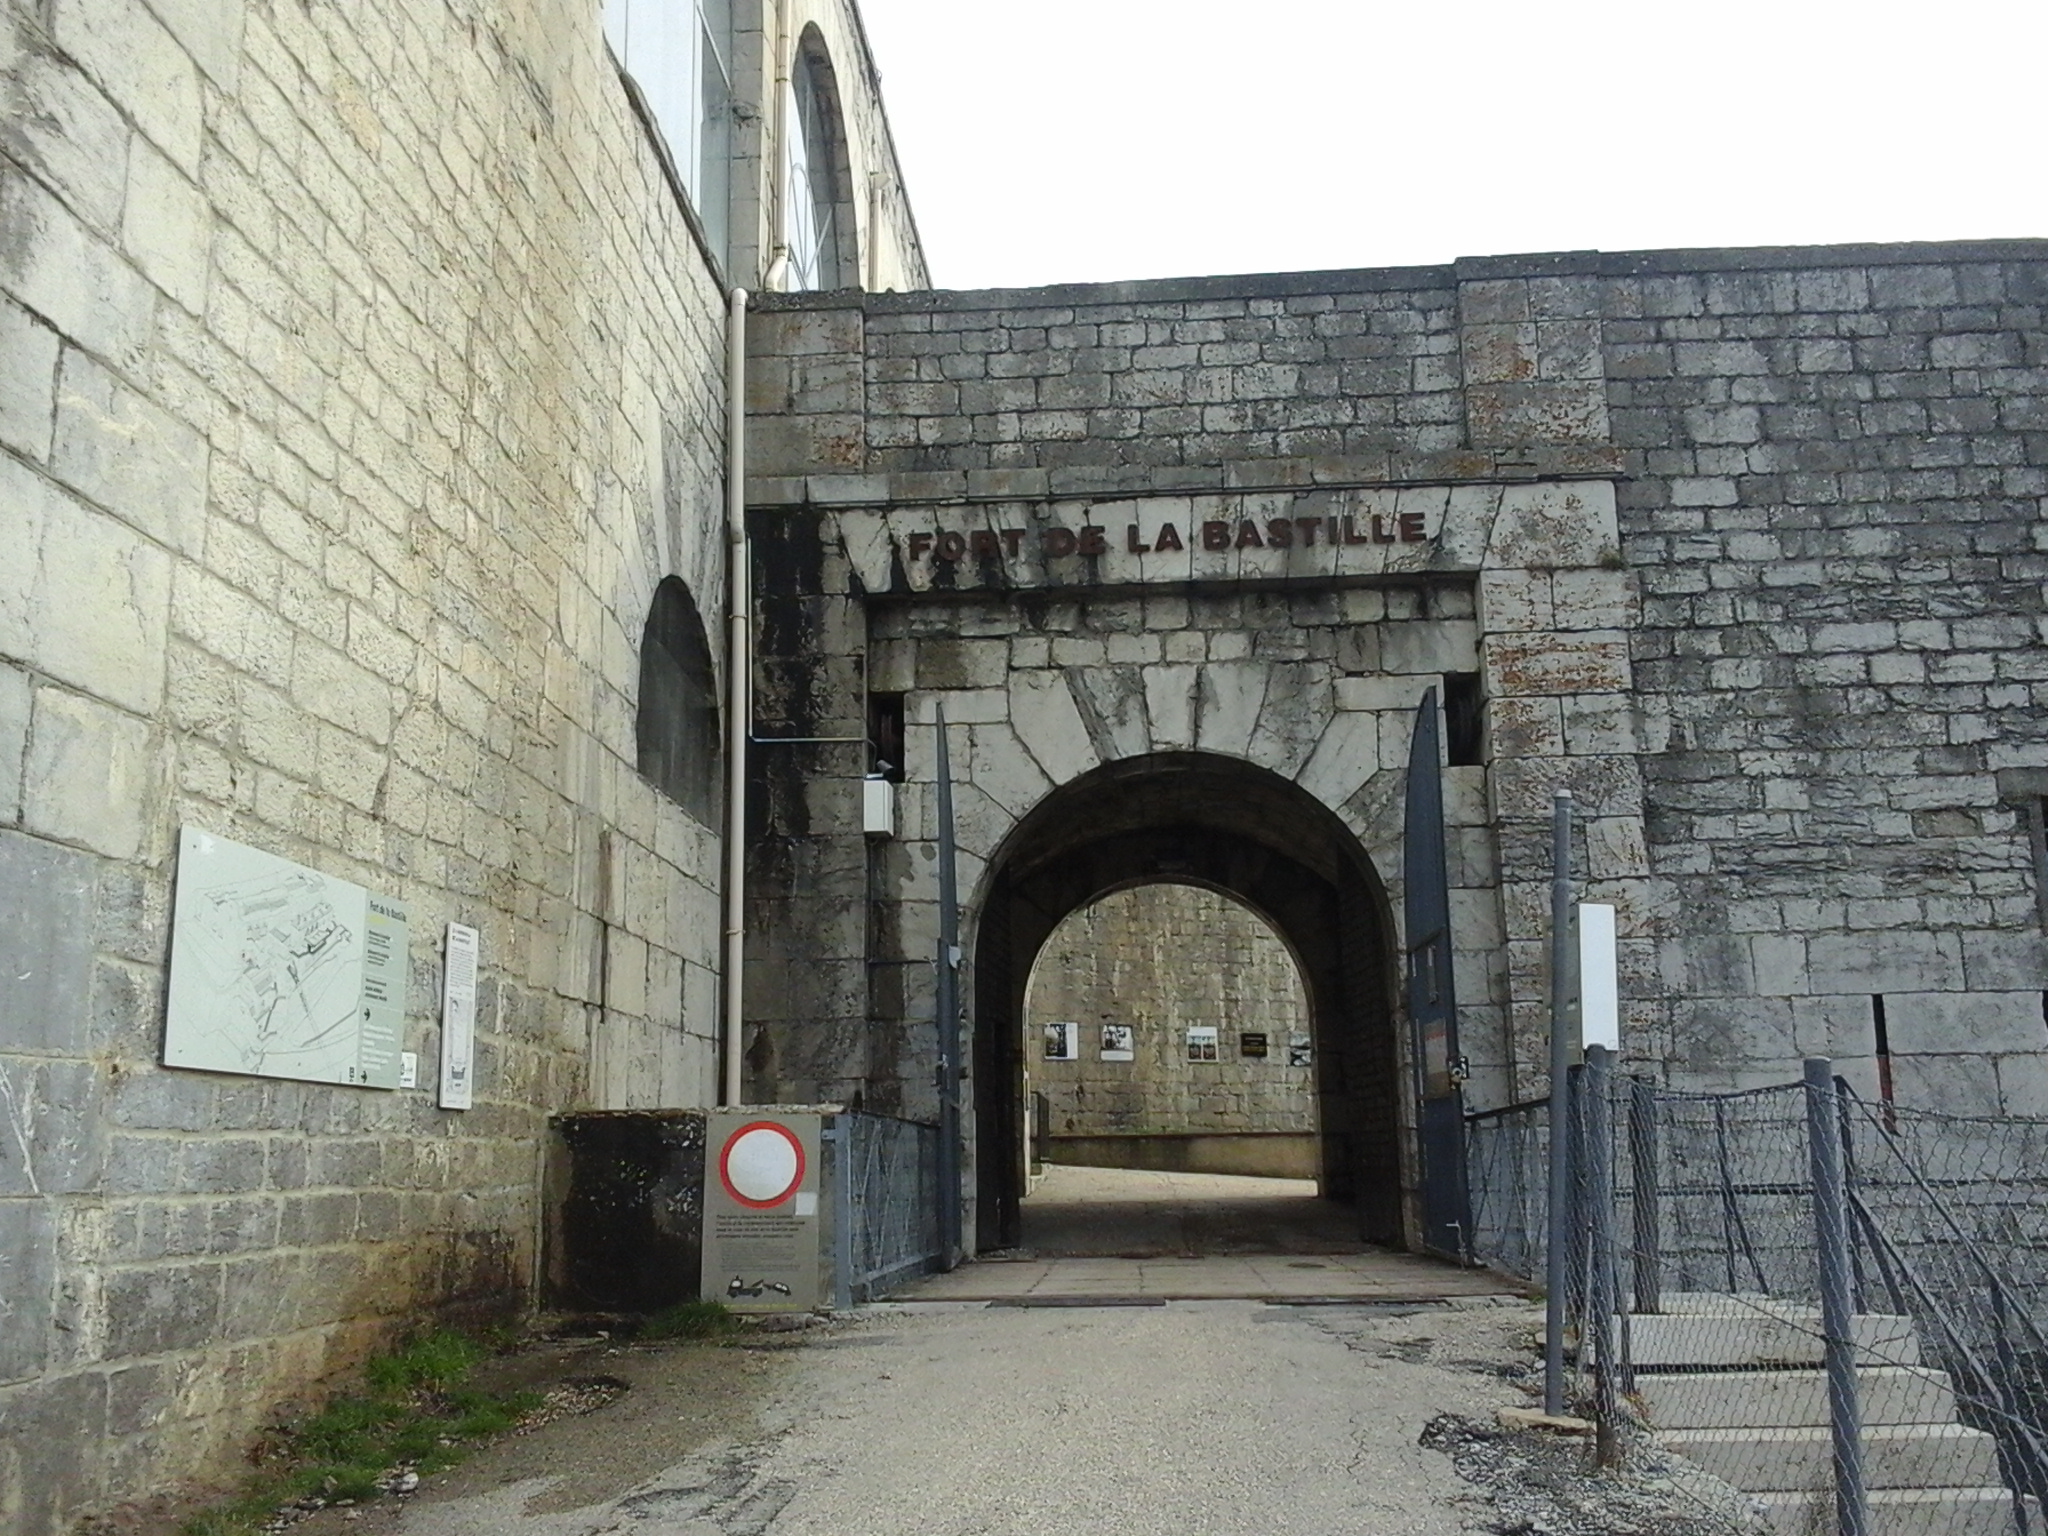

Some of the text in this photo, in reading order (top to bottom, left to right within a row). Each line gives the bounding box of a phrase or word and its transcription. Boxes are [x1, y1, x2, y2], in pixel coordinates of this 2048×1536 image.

[908, 512, 1428, 561] FORT DE LA BASTILLE
